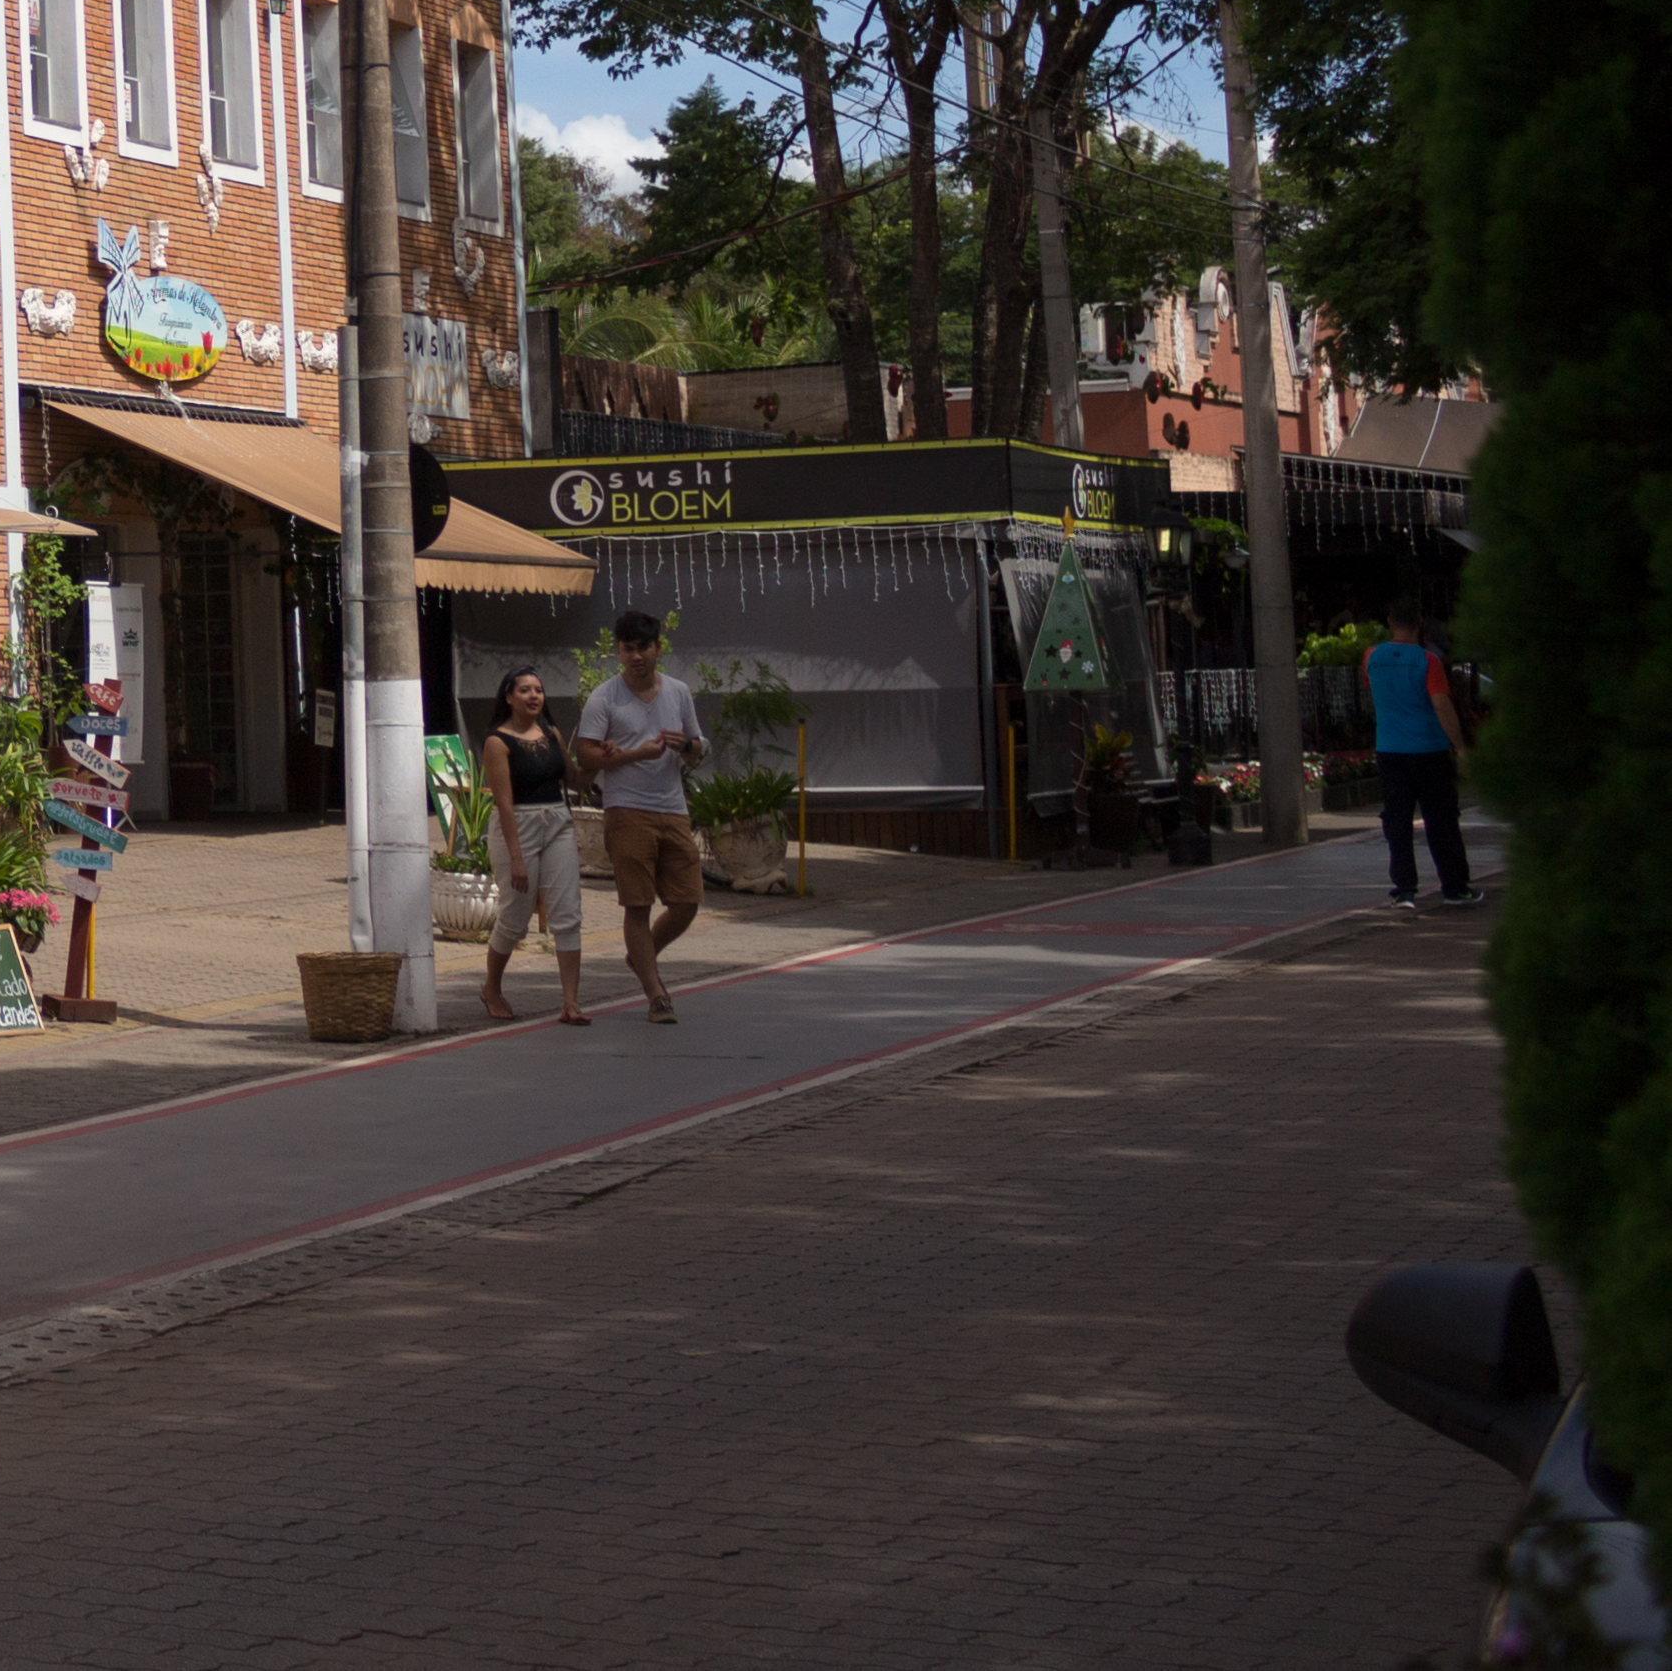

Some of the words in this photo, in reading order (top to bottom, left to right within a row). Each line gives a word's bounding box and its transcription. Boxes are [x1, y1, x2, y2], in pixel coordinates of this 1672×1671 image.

[403, 331, 462, 361] sushi
[608, 461, 732, 489] sushi
[612, 489, 731, 523] BLOEM
